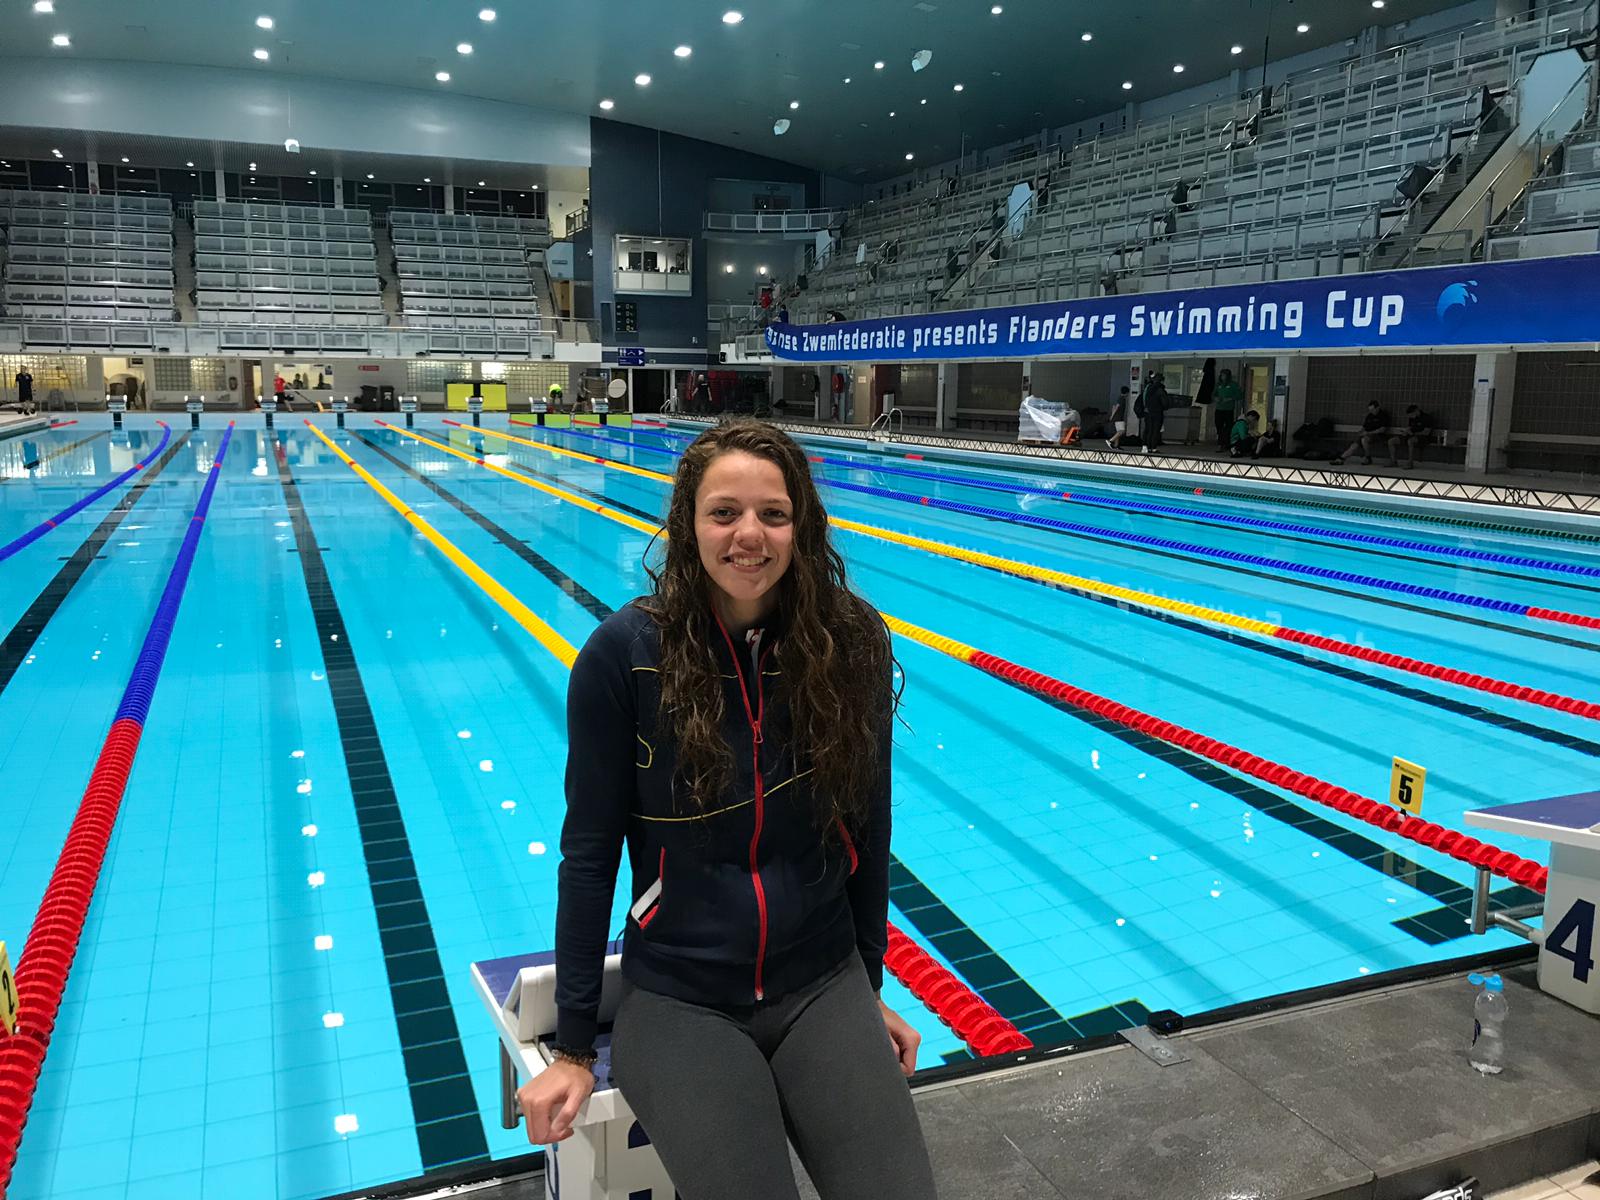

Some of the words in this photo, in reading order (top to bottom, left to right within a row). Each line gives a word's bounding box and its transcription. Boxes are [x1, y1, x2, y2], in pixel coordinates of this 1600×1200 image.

[802, 324, 906, 352] Zwemfederatie
[913, 318, 998, 353] presents
[1008, 311, 1116, 343] Flanders
[1130, 295, 1303, 338] Swimming
[1326, 290, 1404, 335] Cup
[1399, 774, 1413, 805] 5
[1545, 898, 1596, 985] 4
